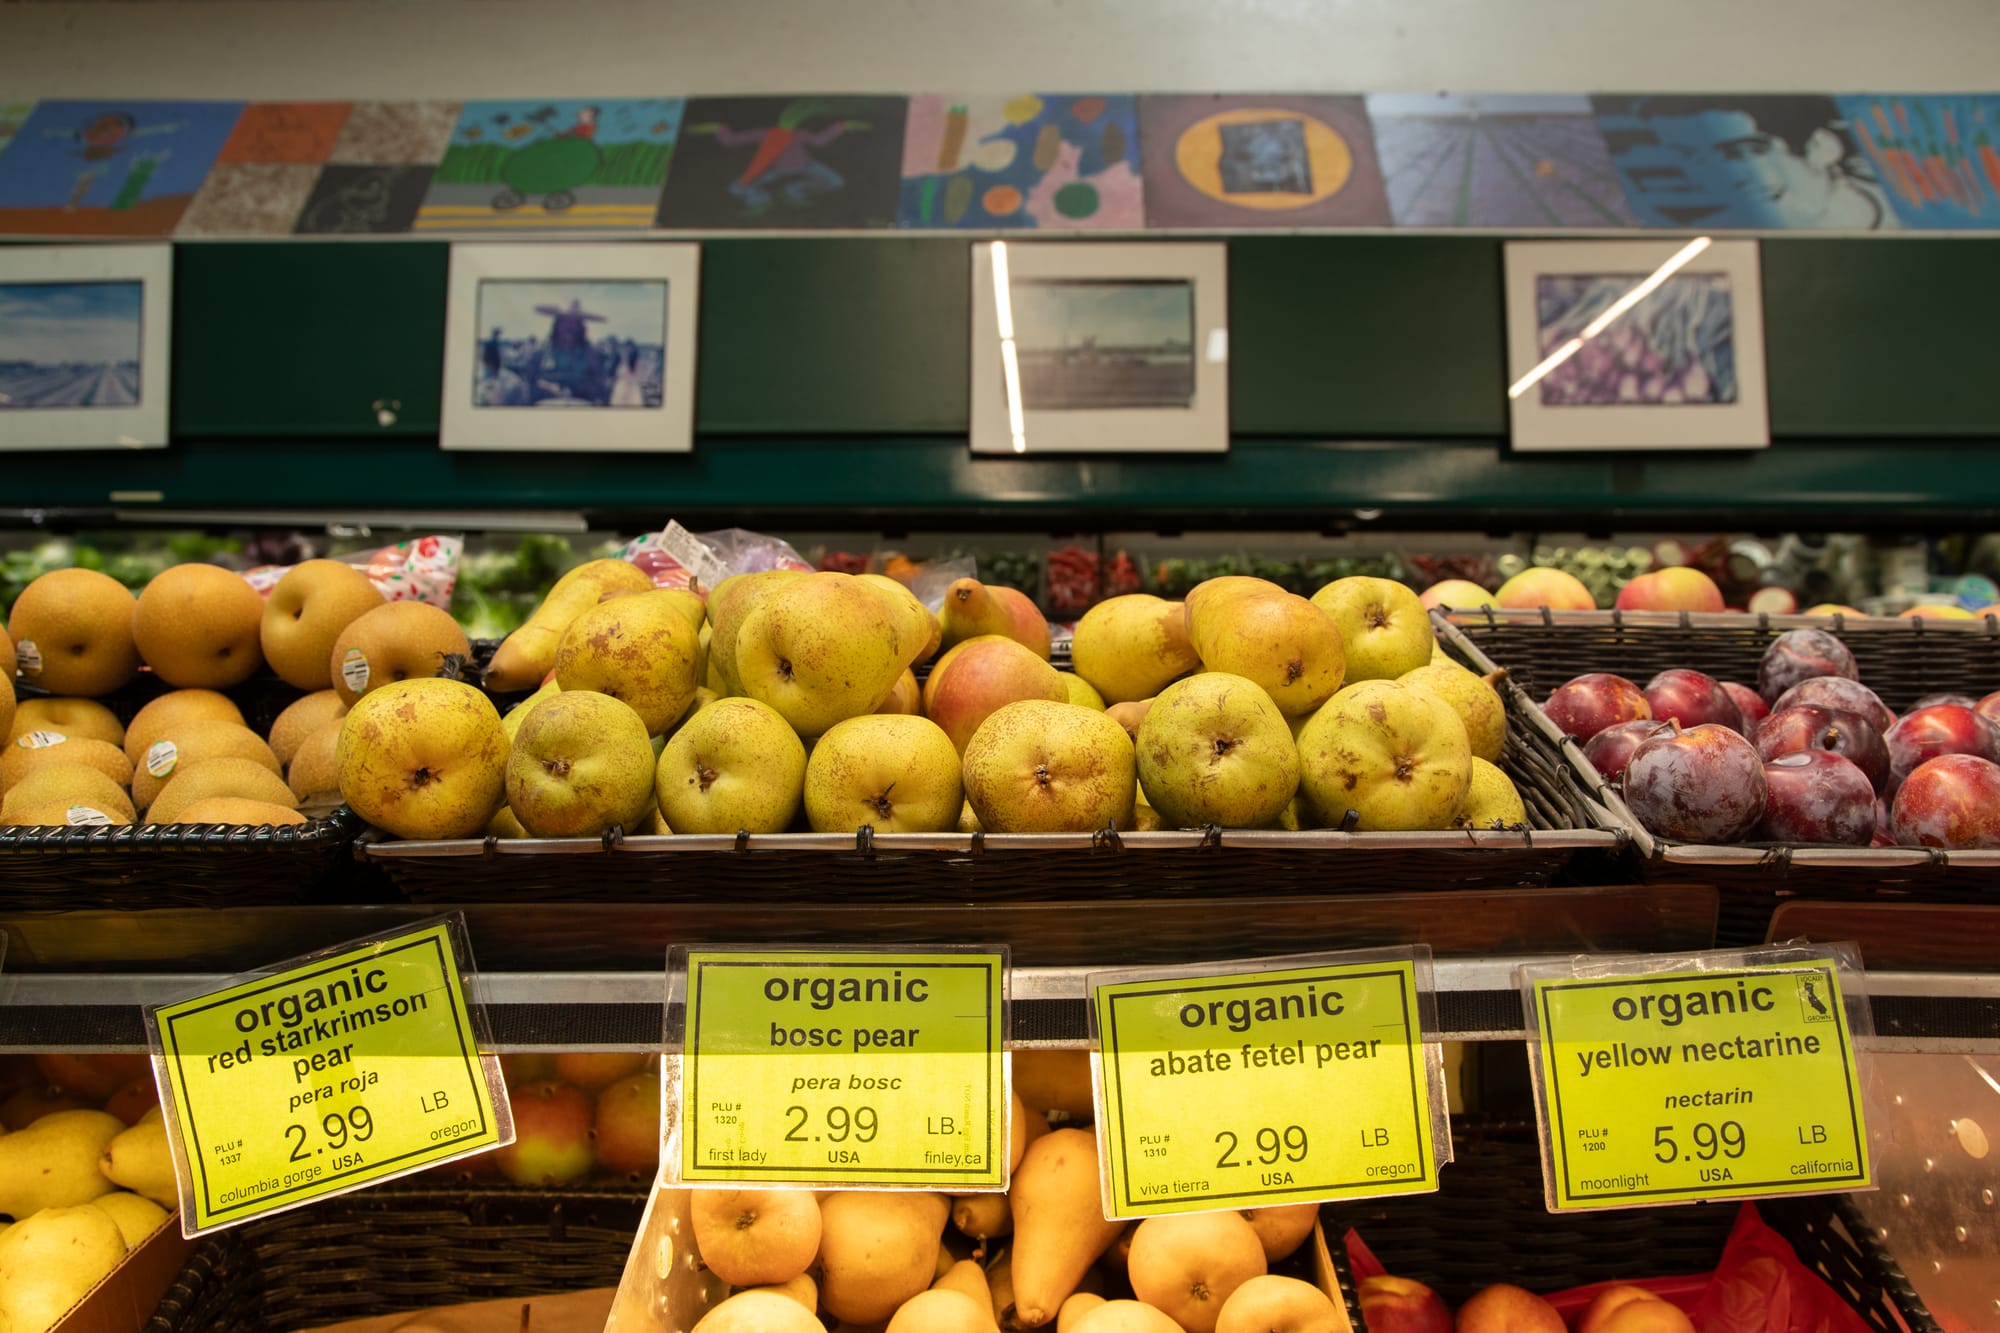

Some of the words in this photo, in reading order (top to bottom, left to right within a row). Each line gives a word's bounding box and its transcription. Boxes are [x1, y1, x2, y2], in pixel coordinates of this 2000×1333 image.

[764, 971, 928, 1009] organic
[235, 968, 388, 1032] organic
[1180, 986, 1344, 1032] organic
[1613, 981, 1775, 1026] organic
[208, 1040, 252, 1073] red
[261, 994, 427, 1057] starkrimson
[771, 1022, 842, 1047] bosc
[854, 1028, 919, 1052] pear
[293, 1043, 354, 1082] pear
[1150, 1049, 1232, 1076] abate
[1241, 1040, 1304, 1069] fetel
[1316, 1038, 1381, 1068] pear
[1578, 1043, 1671, 1076] yellow
[1683, 1033, 1820, 1063] nectarine
[289, 1082, 334, 1112] pera
[341, 1070, 378, 1094] roja
[792, 1077, 840, 1093] pera
[848, 1074, 902, 1090] bosc
[421, 1091, 449, 1113] LB
[712, 1102, 733, 1112] PLU
[736, 1102, 742, 1111] #
[1665, 1088, 1753, 1109] nectarin
[714, 1115, 737, 1125] 1320
[784, 1105, 878, 1142] 2.99
[927, 1117, 962, 1135] LB.
[285, 1106, 374, 1162] 2.99
[430, 1118, 477, 1142] oregon
[1140, 1135, 1161, 1145] PLU
[1164, 1134, 1170, 1142] #
[1361, 1128, 1389, 1148] LB
[1579, 1129, 1600, 1138] PLU
[1602, 1128, 1608, 1137] #
[1798, 1125, 1827, 1145] LB
[214, 1141, 235, 1155] PLU
[237, 1139, 243, 1147] #
[1215, 1125, 1308, 1169] 2.99
[1583, 1142, 1606, 1152] 1200
[1654, 1120, 1745, 1163] 5.99
[220, 1152, 242, 1166] 1337
[332, 1154, 364, 1171] USA
[709, 1149, 734, 1162] first
[738, 1149, 767, 1164] lady
[828, 1151, 860, 1163] USA
[924, 1151, 981, 1166] finley,ca
[1144, 1148, 1167, 1158] 1310
[1366, 1162, 1415, 1178] oregon
[1700, 1168, 1733, 1182] USA
[1790, 1160, 1854, 1176] california
[220, 1177, 279, 1203] columbia
[284, 1165, 321, 1188] gorge
[1140, 1183, 1169, 1196] viva
[1173, 1179, 1210, 1194] tierra
[1261, 1173, 1294, 1186] USA
[1580, 1174, 1649, 1191] moonlight
